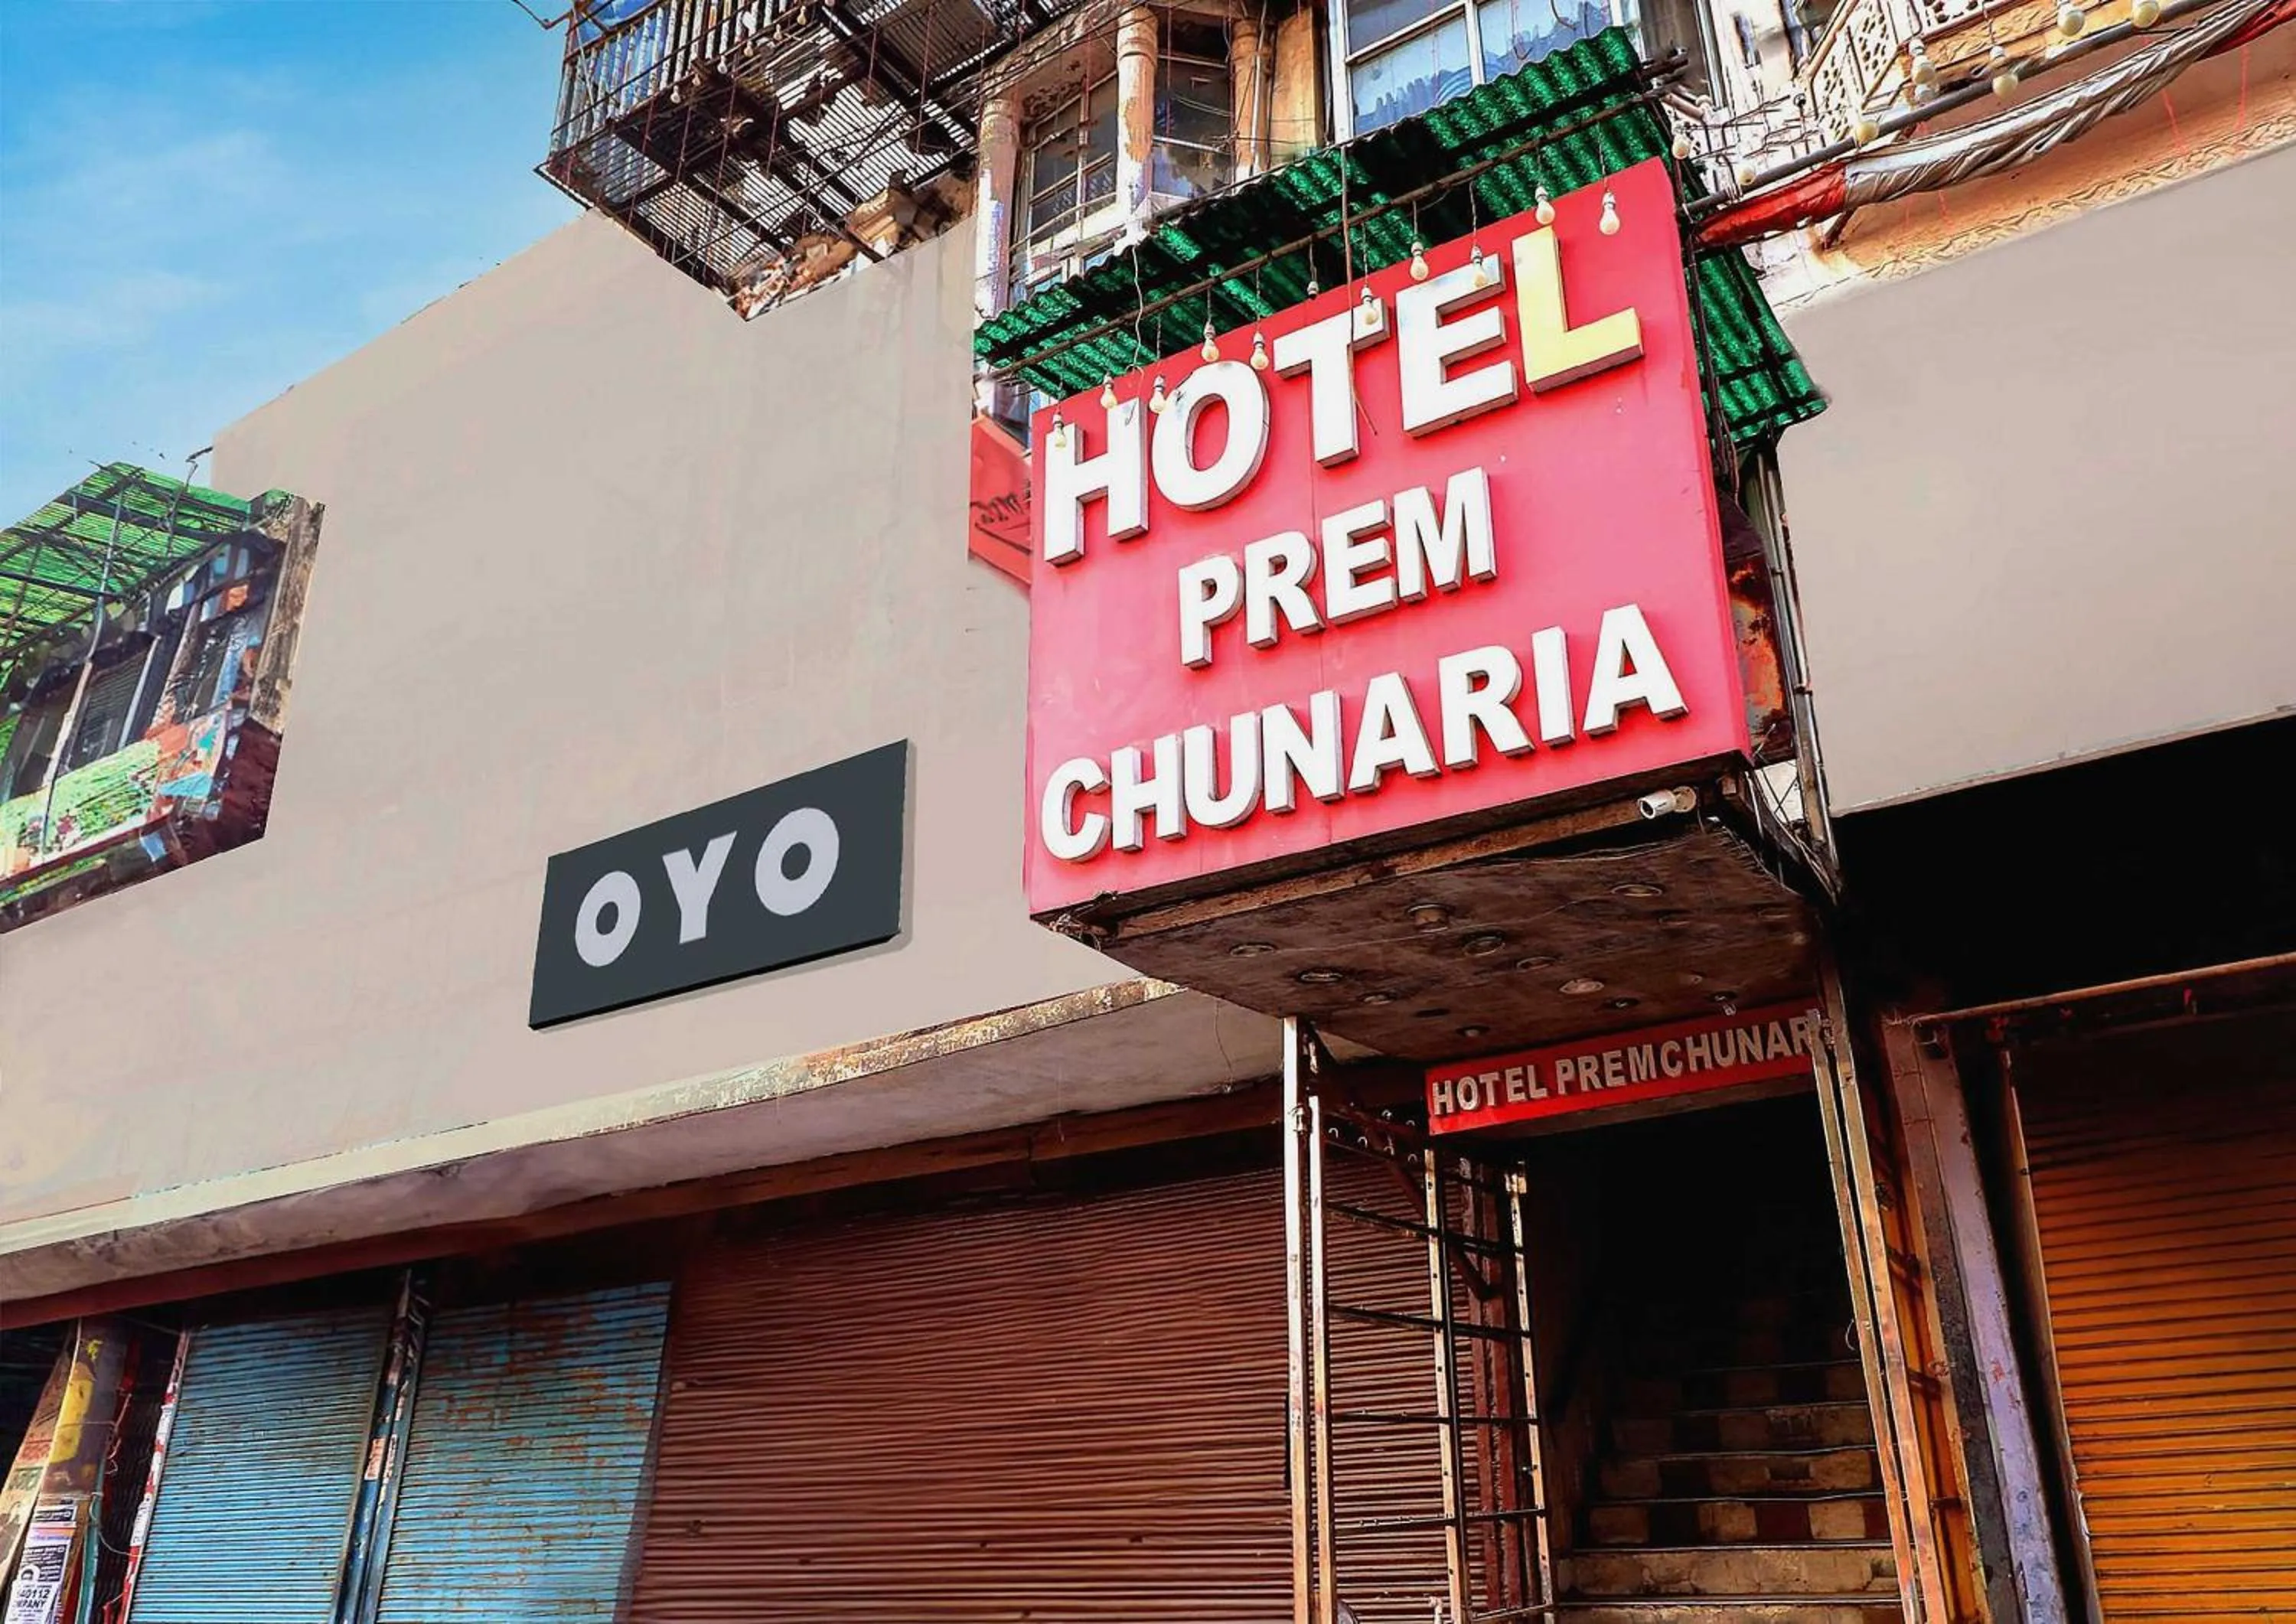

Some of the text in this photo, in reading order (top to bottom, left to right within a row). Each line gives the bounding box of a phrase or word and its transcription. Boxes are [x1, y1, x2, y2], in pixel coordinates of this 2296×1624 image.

[1042, 225, 1643, 566] HOTEL
[1178, 465, 1498, 670] PREM
[1040, 602, 1688, 863] CHUNARIA
[575, 807, 840, 968] OYO
[1432, 1064, 1548, 1116] HOTEL
